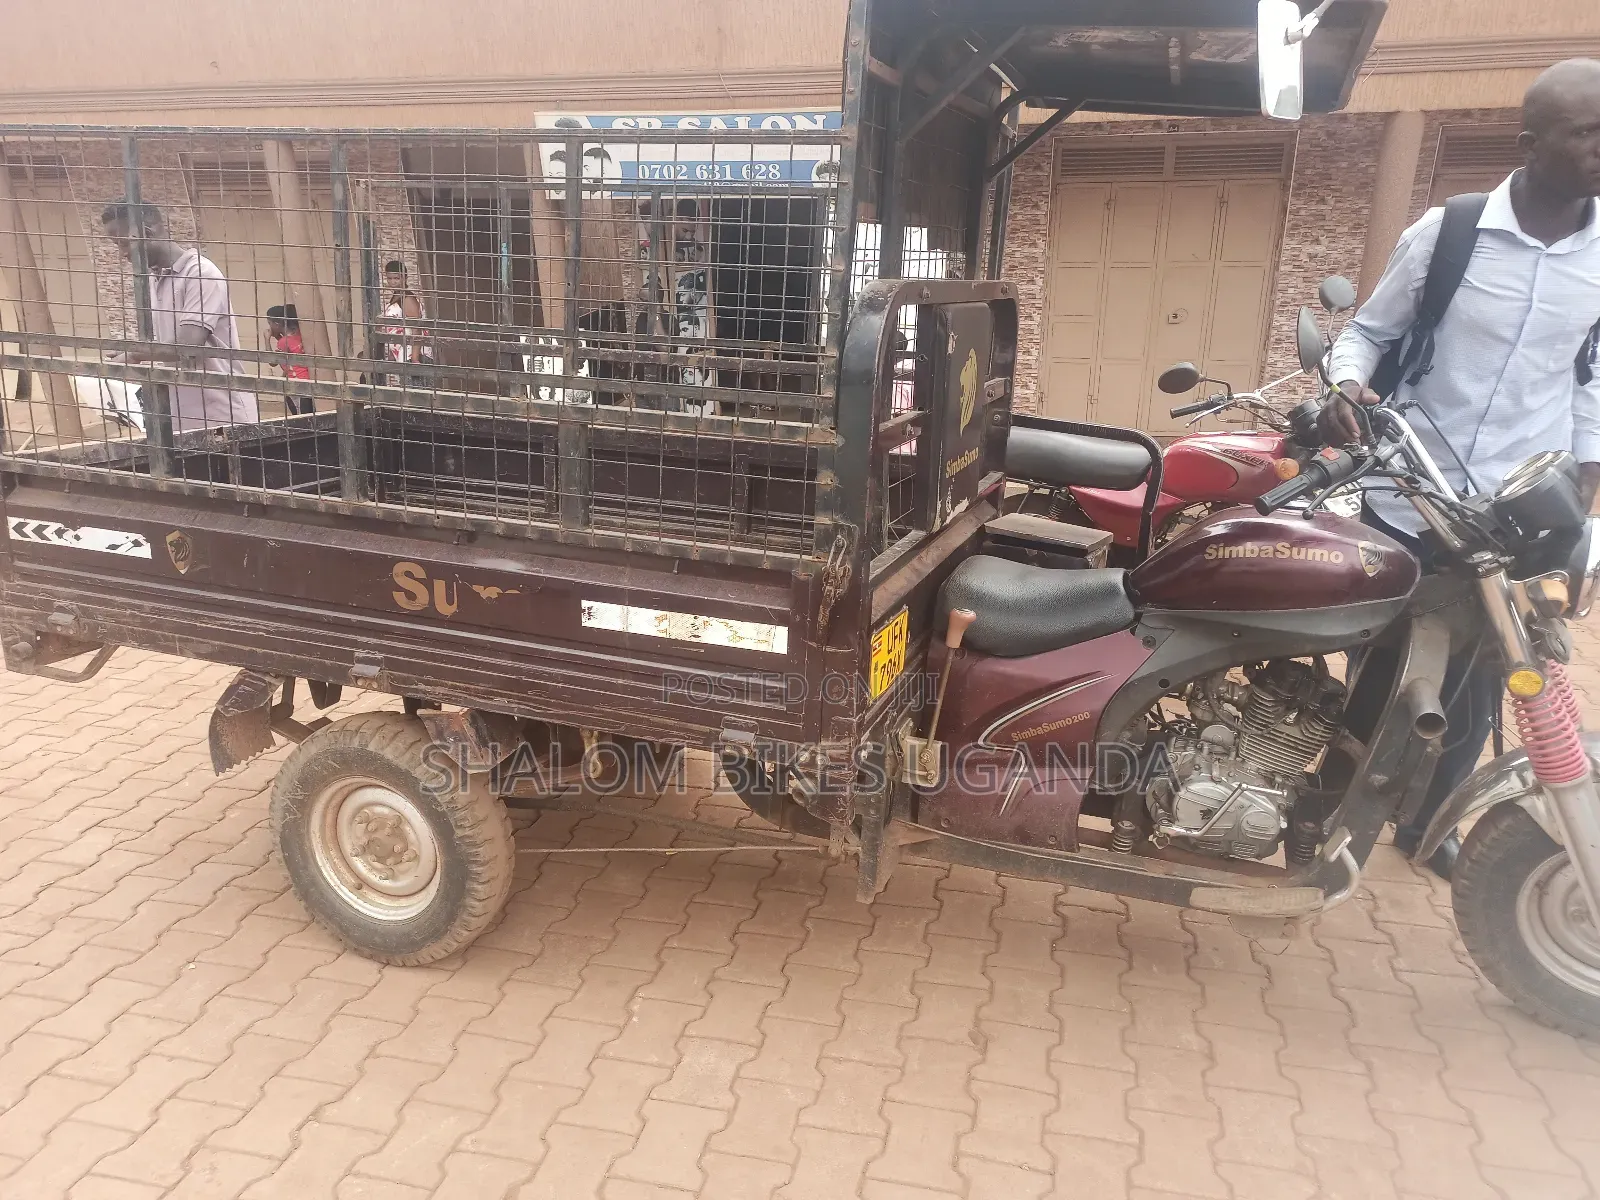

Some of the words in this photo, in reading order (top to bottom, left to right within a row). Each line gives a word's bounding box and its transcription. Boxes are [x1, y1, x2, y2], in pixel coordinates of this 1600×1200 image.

[639, 164, 688, 180] 0702
[696, 164, 733, 180] 631
[741, 163, 781, 180] 628
[1204, 541, 1344, 564] SimbaSumo
[1011, 711, 1091, 742] SimbaSumo200
